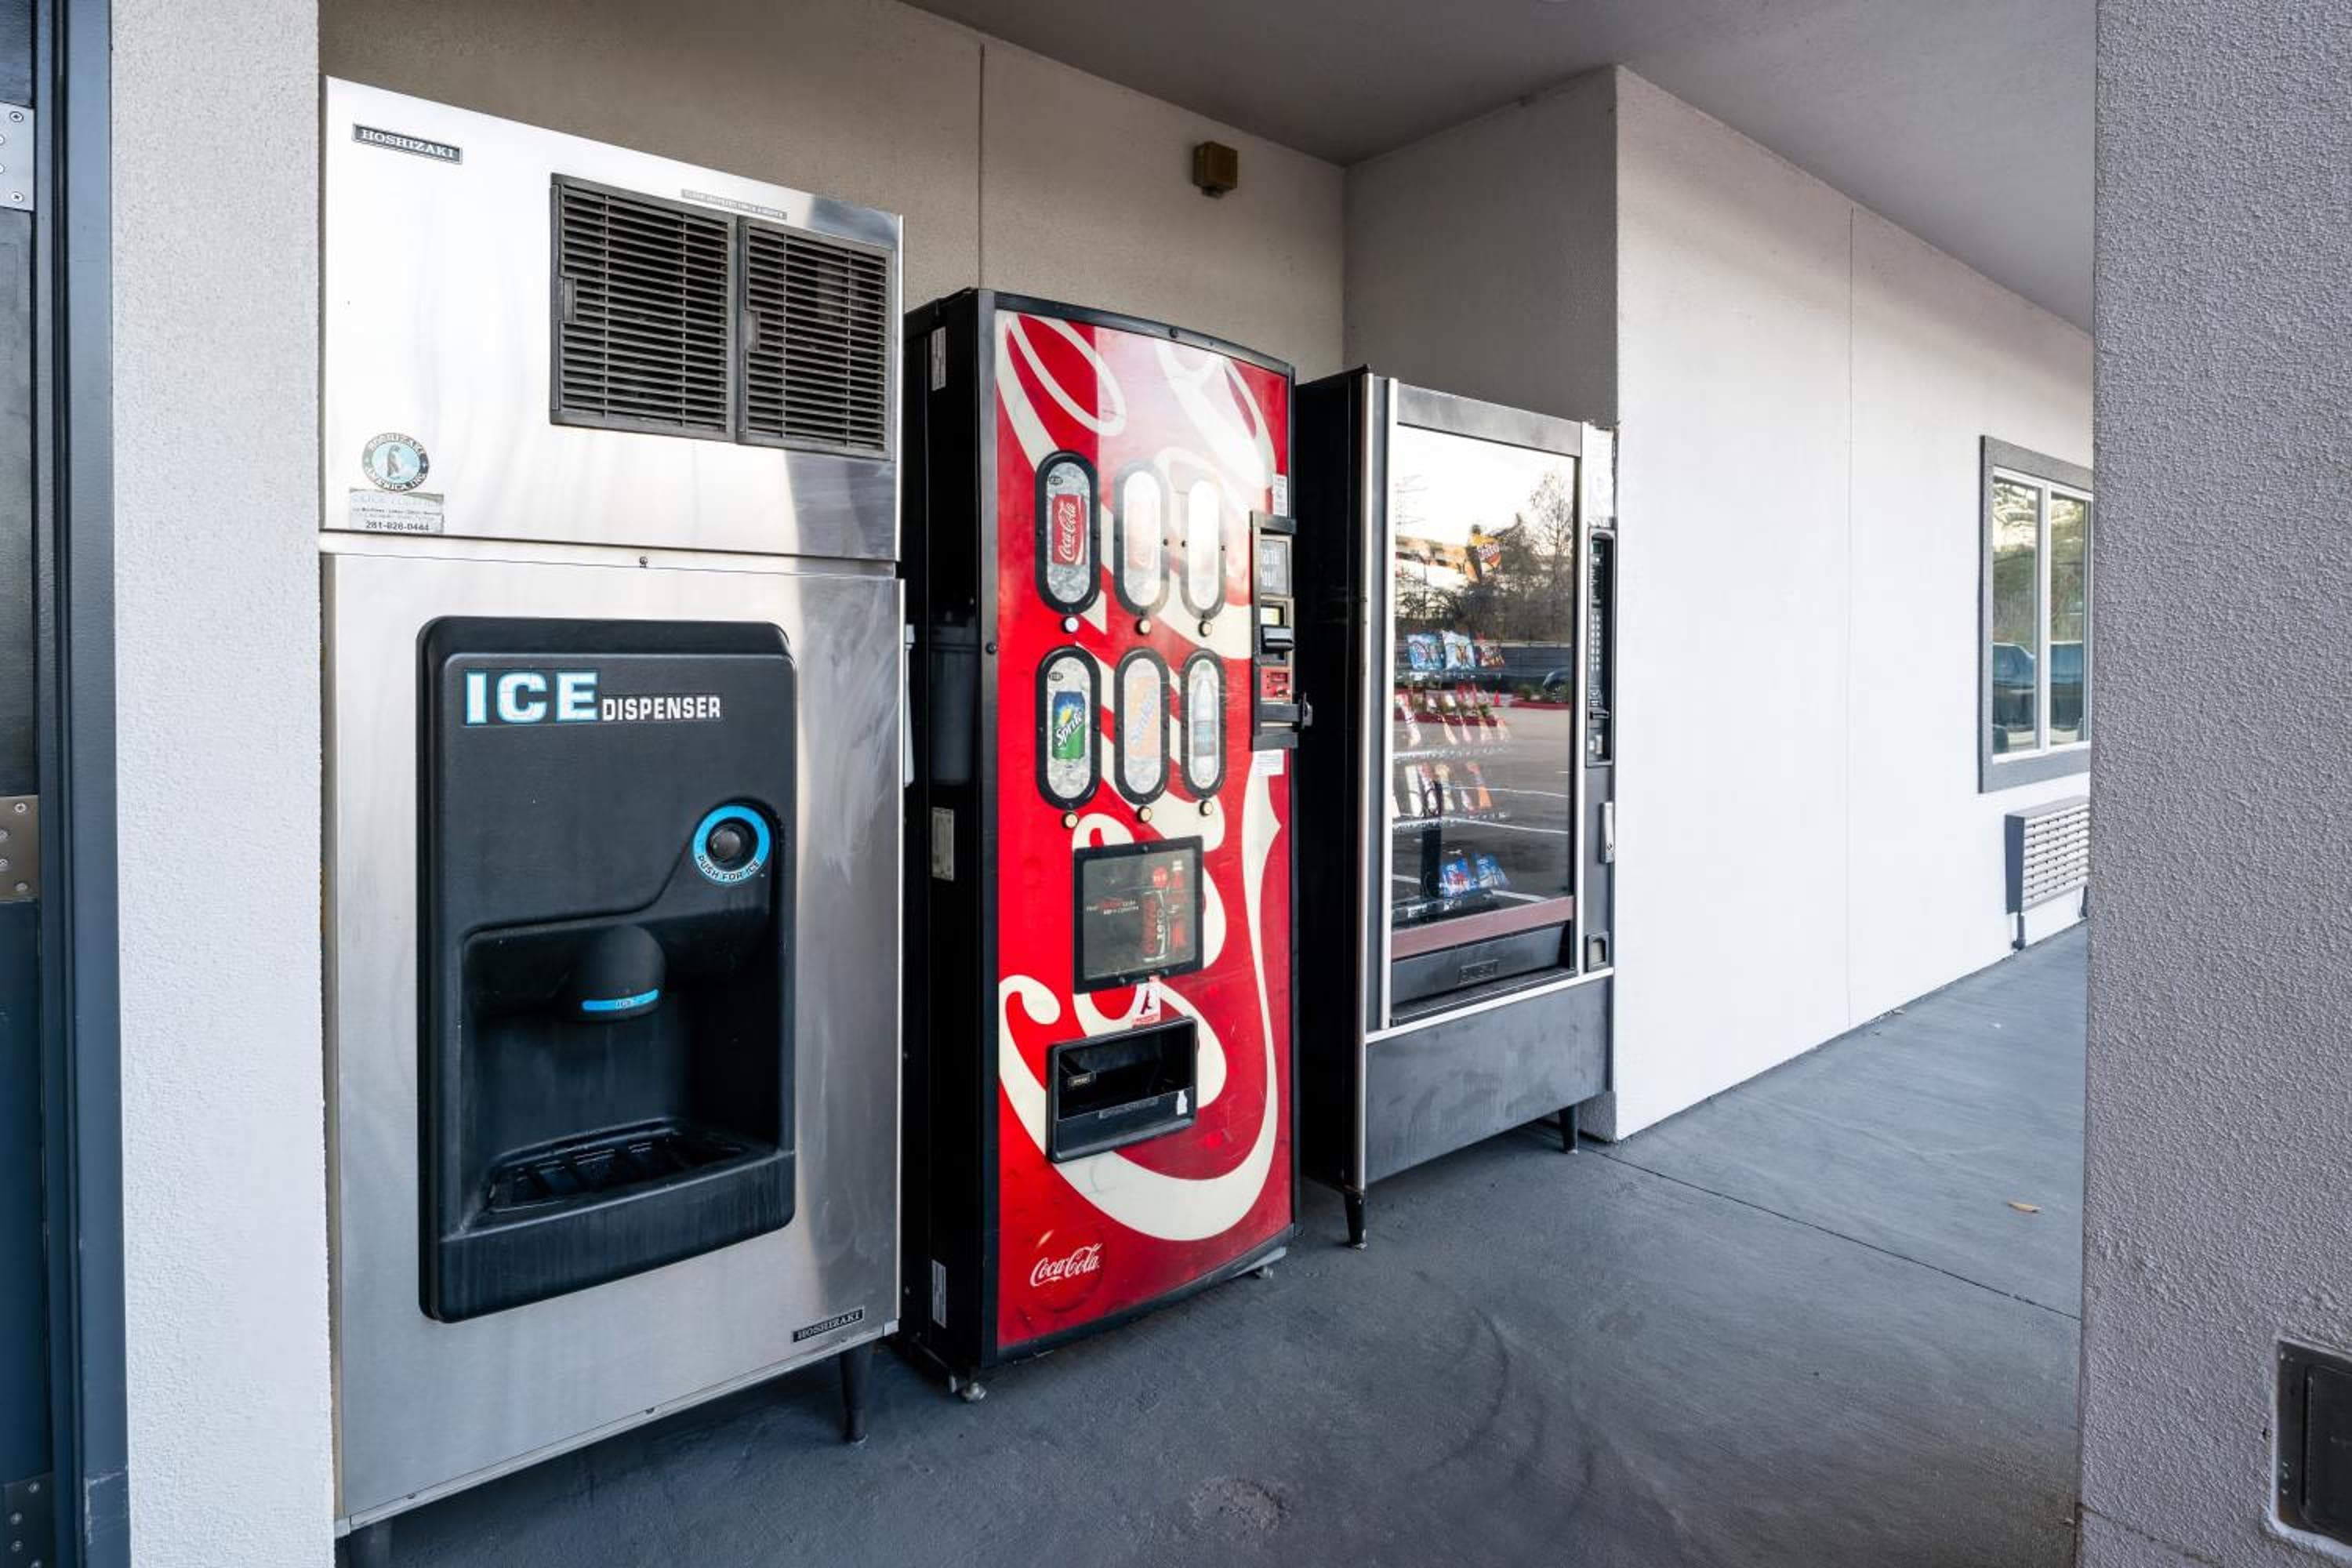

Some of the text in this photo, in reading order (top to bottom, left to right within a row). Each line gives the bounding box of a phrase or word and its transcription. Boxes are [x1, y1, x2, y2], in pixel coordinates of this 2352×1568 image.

[361, 129, 454, 158] HOSHIZAKI
[466, 671, 721, 725] ICE DISPENSER
[1055, 707, 1084, 748] Sprite
[698, 855, 760, 880] PUSH FOR ICE
[797, 1312, 860, 1339] HOSHIZAKI
